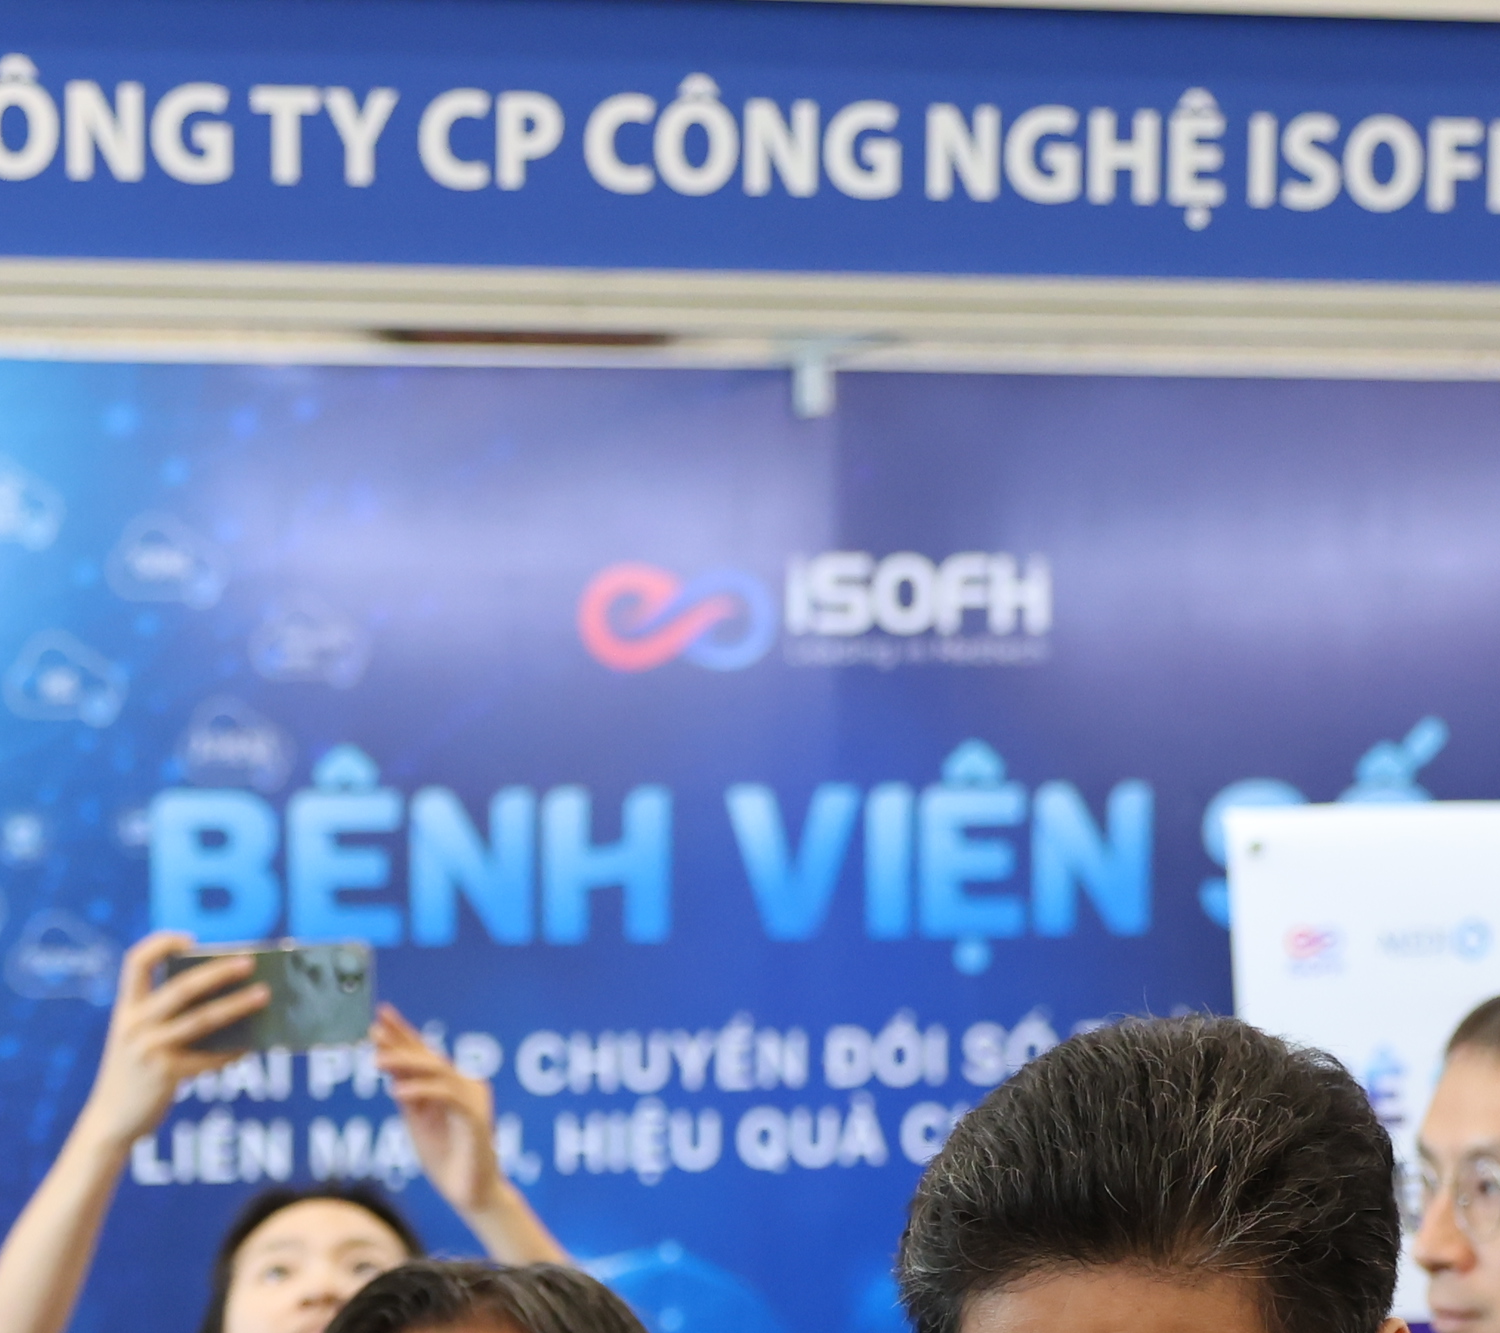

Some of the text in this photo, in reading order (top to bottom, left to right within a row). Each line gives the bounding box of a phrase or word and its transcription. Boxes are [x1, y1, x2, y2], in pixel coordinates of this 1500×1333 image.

[249, 84, 399, 189] TY
[416, 87, 566, 192] CP
[583, 71, 903, 201] CÔNG
[923, 86, 1226, 232] NGHỆ
[726, 740, 1155, 976] VIỆN
